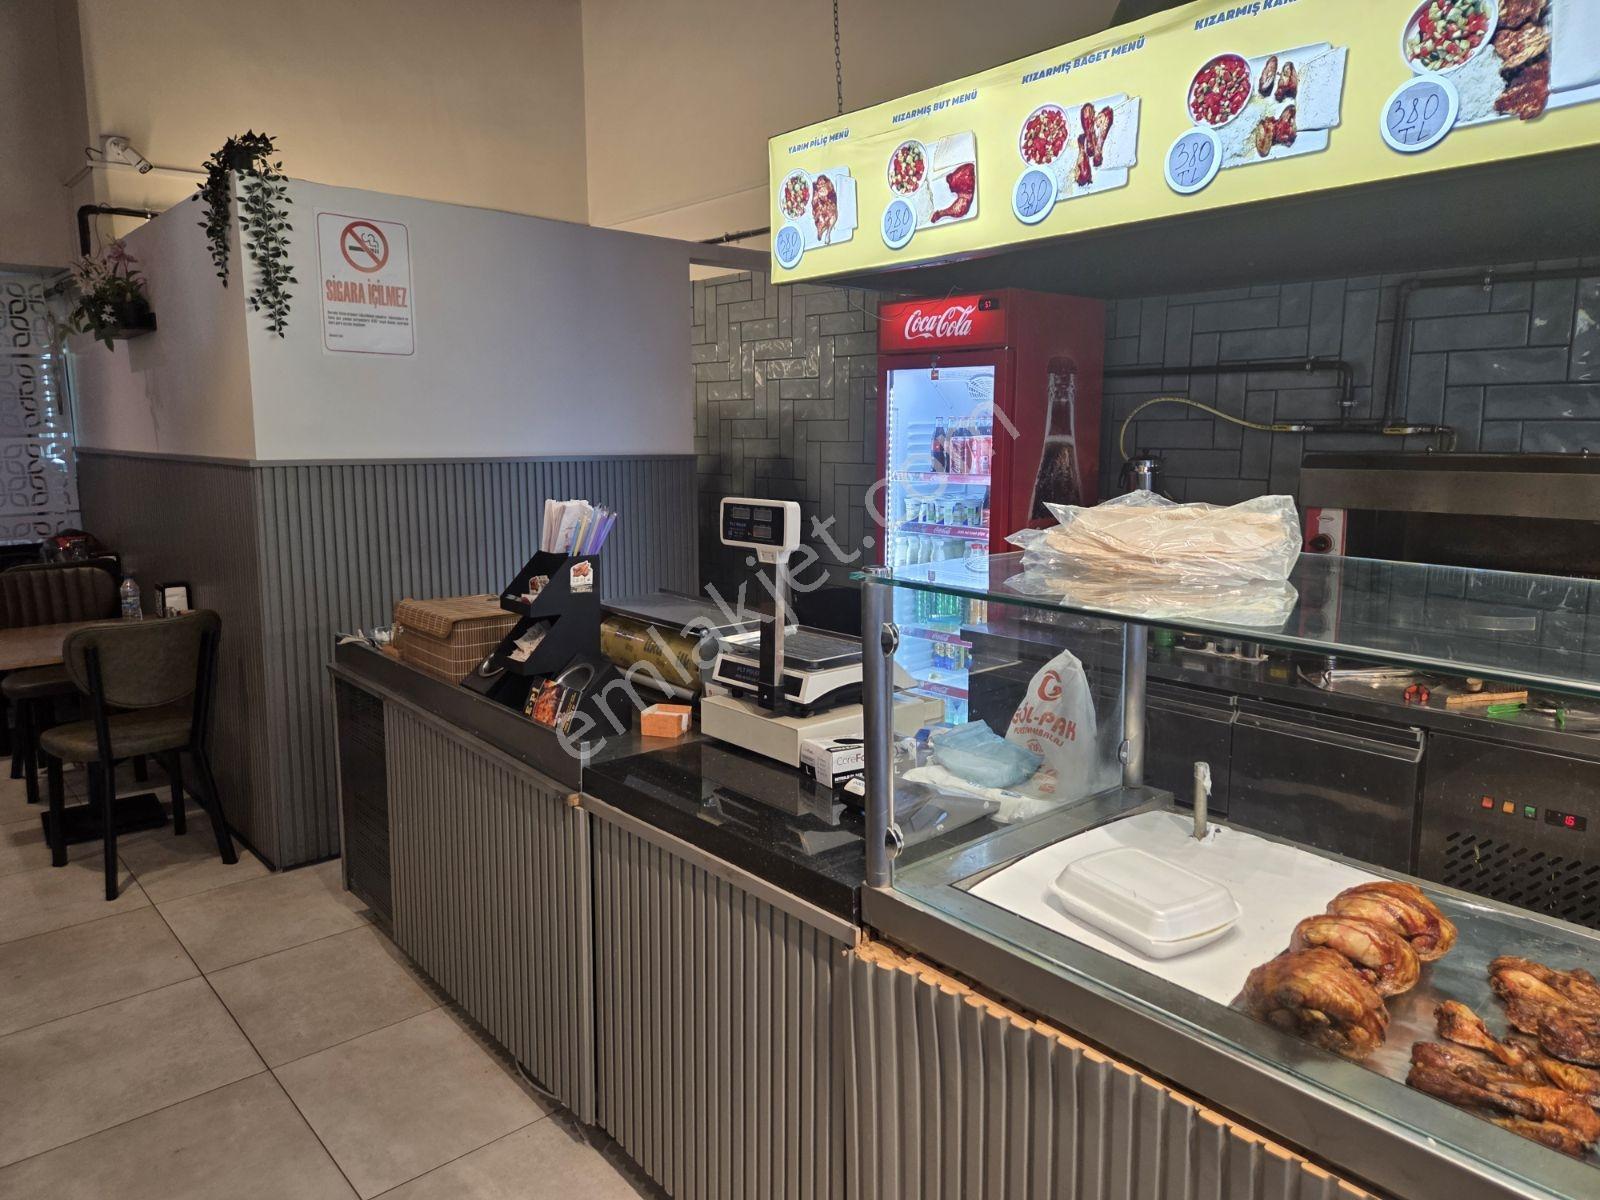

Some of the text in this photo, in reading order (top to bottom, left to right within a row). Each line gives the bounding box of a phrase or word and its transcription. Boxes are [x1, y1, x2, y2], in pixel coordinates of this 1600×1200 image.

[1194, 2, 1261, 30] KIZARMIŞ
[1021, 35, 1146, 84] KIZARMIŞ BAGET MENÜ
[892, 88, 978, 124] KIZARMIŞ BUT MENÜ
[1391, 94, 1440, 130] 380
[788, 127, 850, 154] YARIM PİLİÇ MENÜ
[1398, 121, 1428, 145] TL
[1174, 140, 1212, 171] 380
[1177, 167, 1200, 184] TL
[1019, 179, 1048, 209] 380
[885, 207, 911, 233] 380
[325, 275, 408, 308] SİGARA İÇİLMEZ
